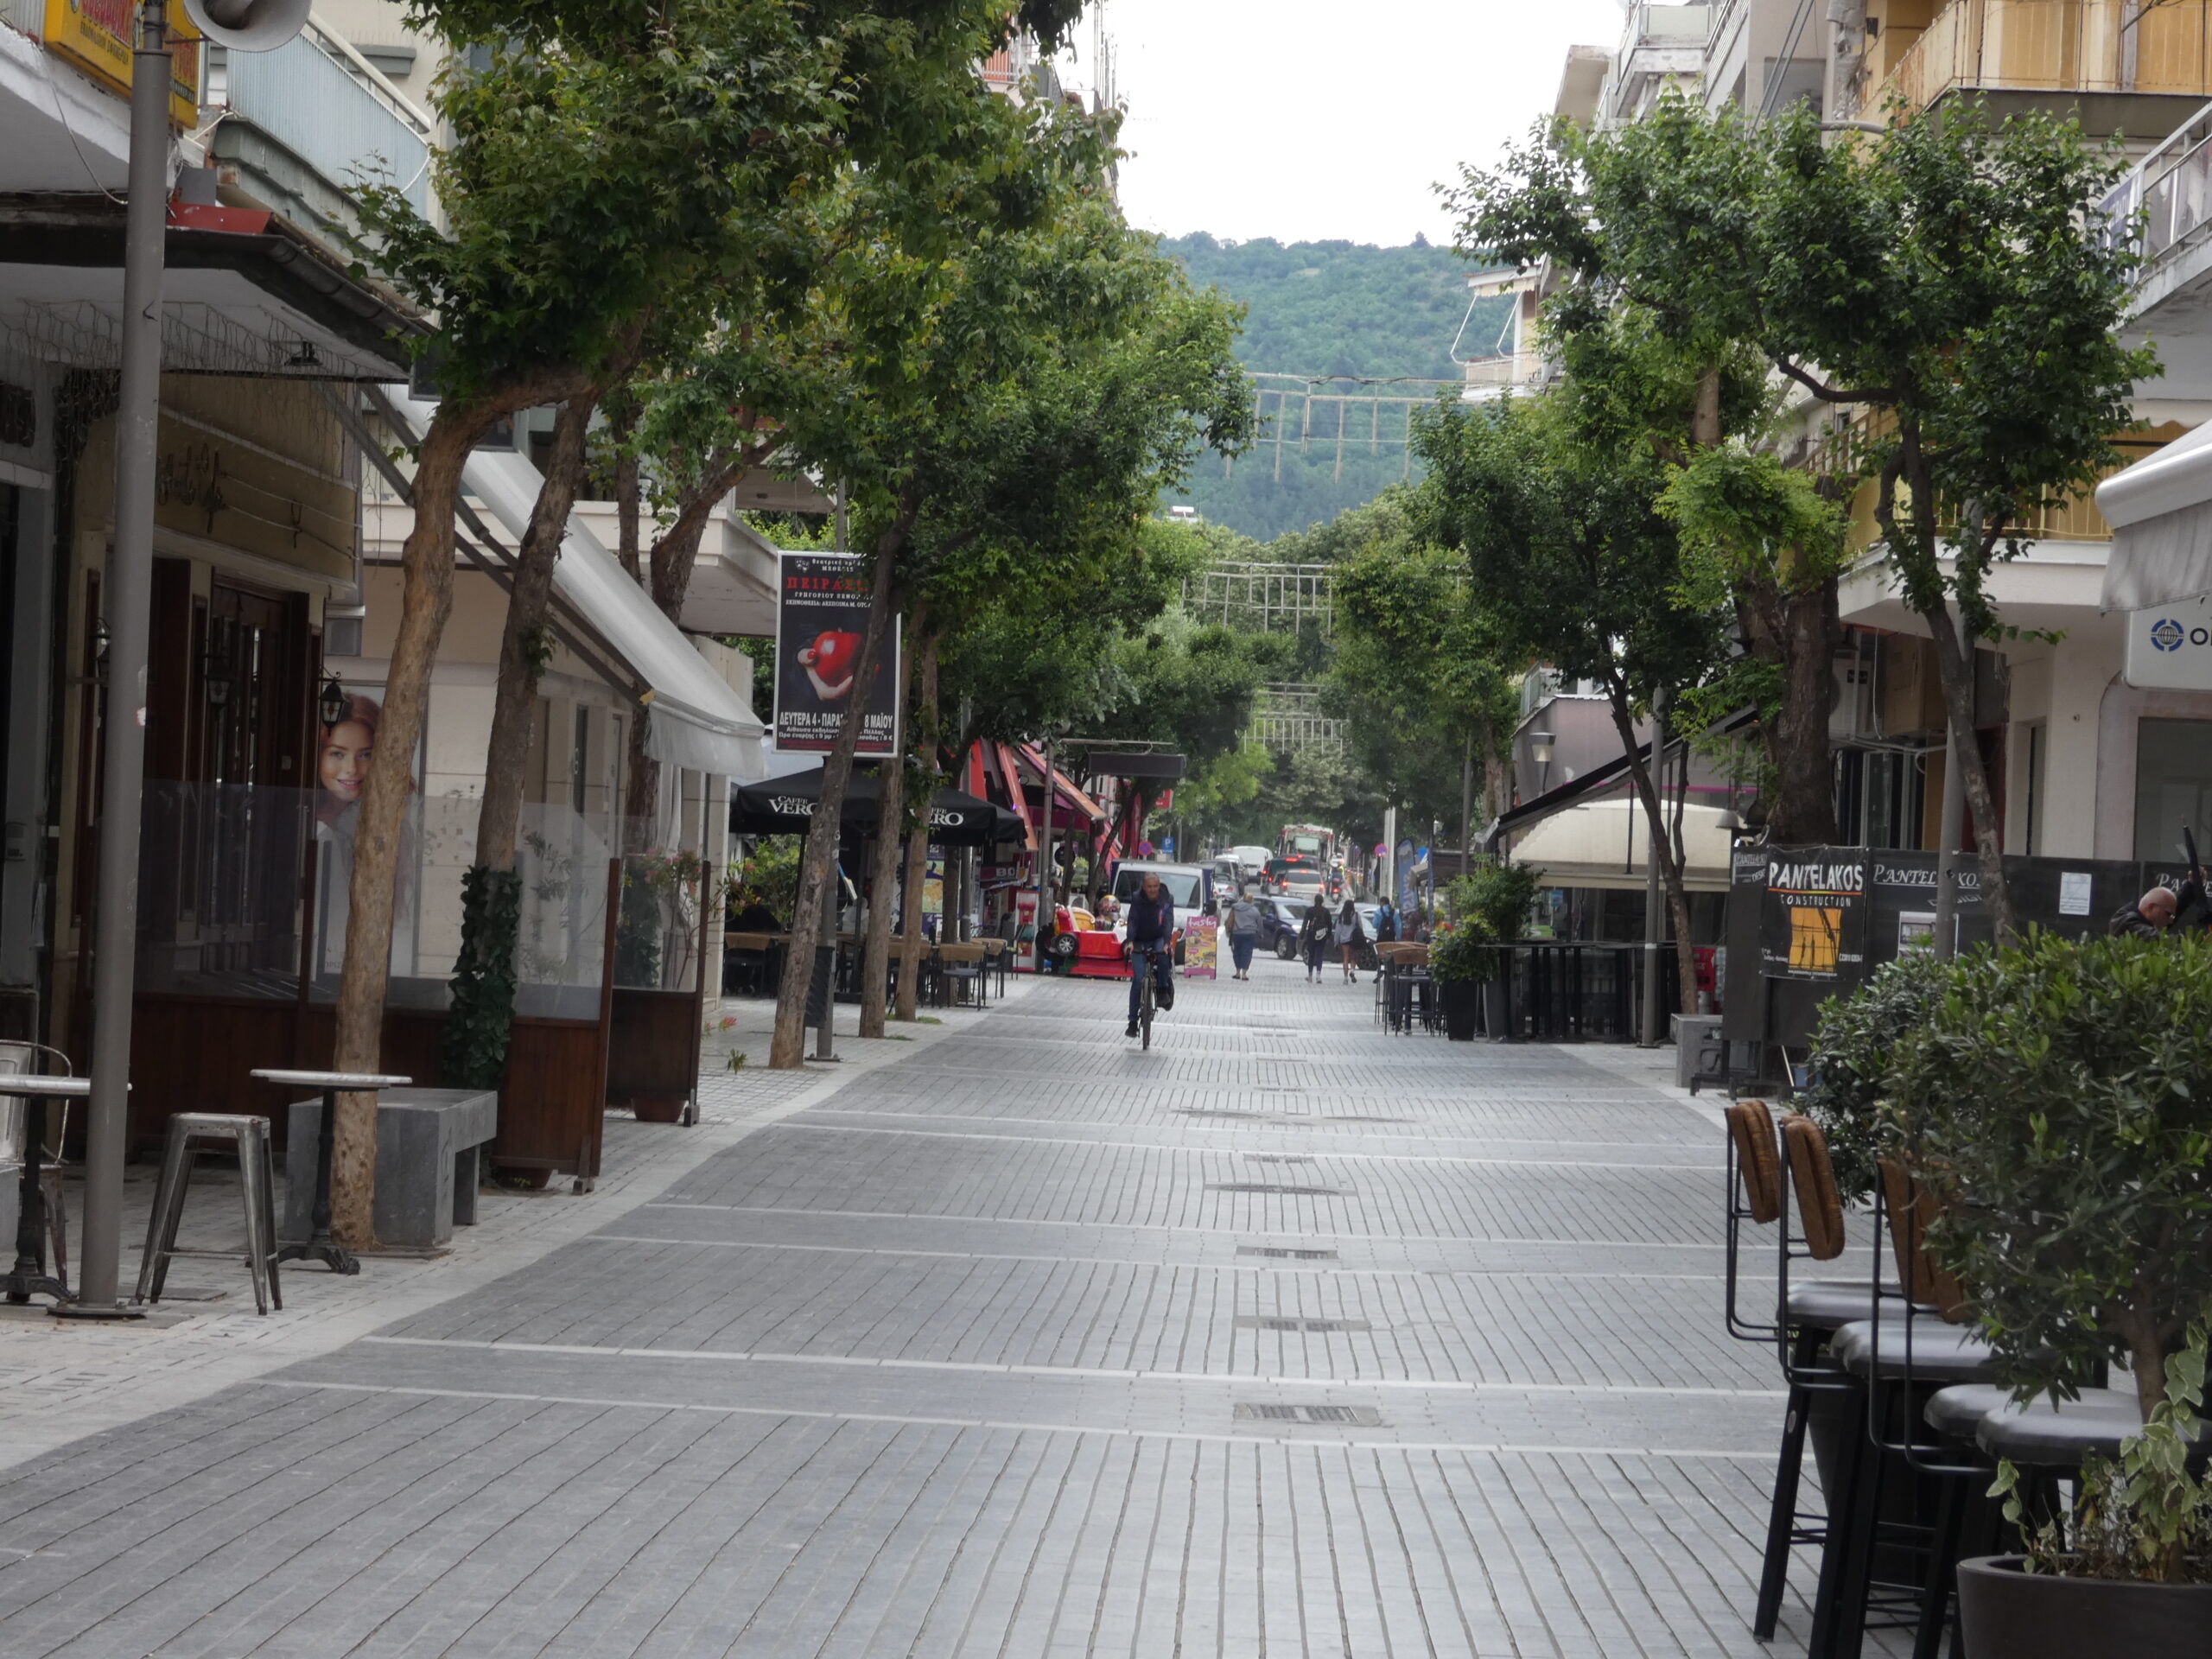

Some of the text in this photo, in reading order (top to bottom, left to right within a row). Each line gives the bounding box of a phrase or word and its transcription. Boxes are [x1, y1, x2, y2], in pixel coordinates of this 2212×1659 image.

[2190, 627, 2212, 646] O
[779, 712, 811, 726] ΔΕΥΤΕΡΑ
[812, 712, 817, 726] 4
[864, 714, 868, 728] 8
[870, 713, 893, 728] ΜΑΪΟΥ
[778, 795, 809, 804] CAFFE
[1769, 861, 1863, 892] PANTELAKOS
[1780, 894, 1852, 907] CONSTRUCTION
[1188, 917, 1217, 929] tasty
